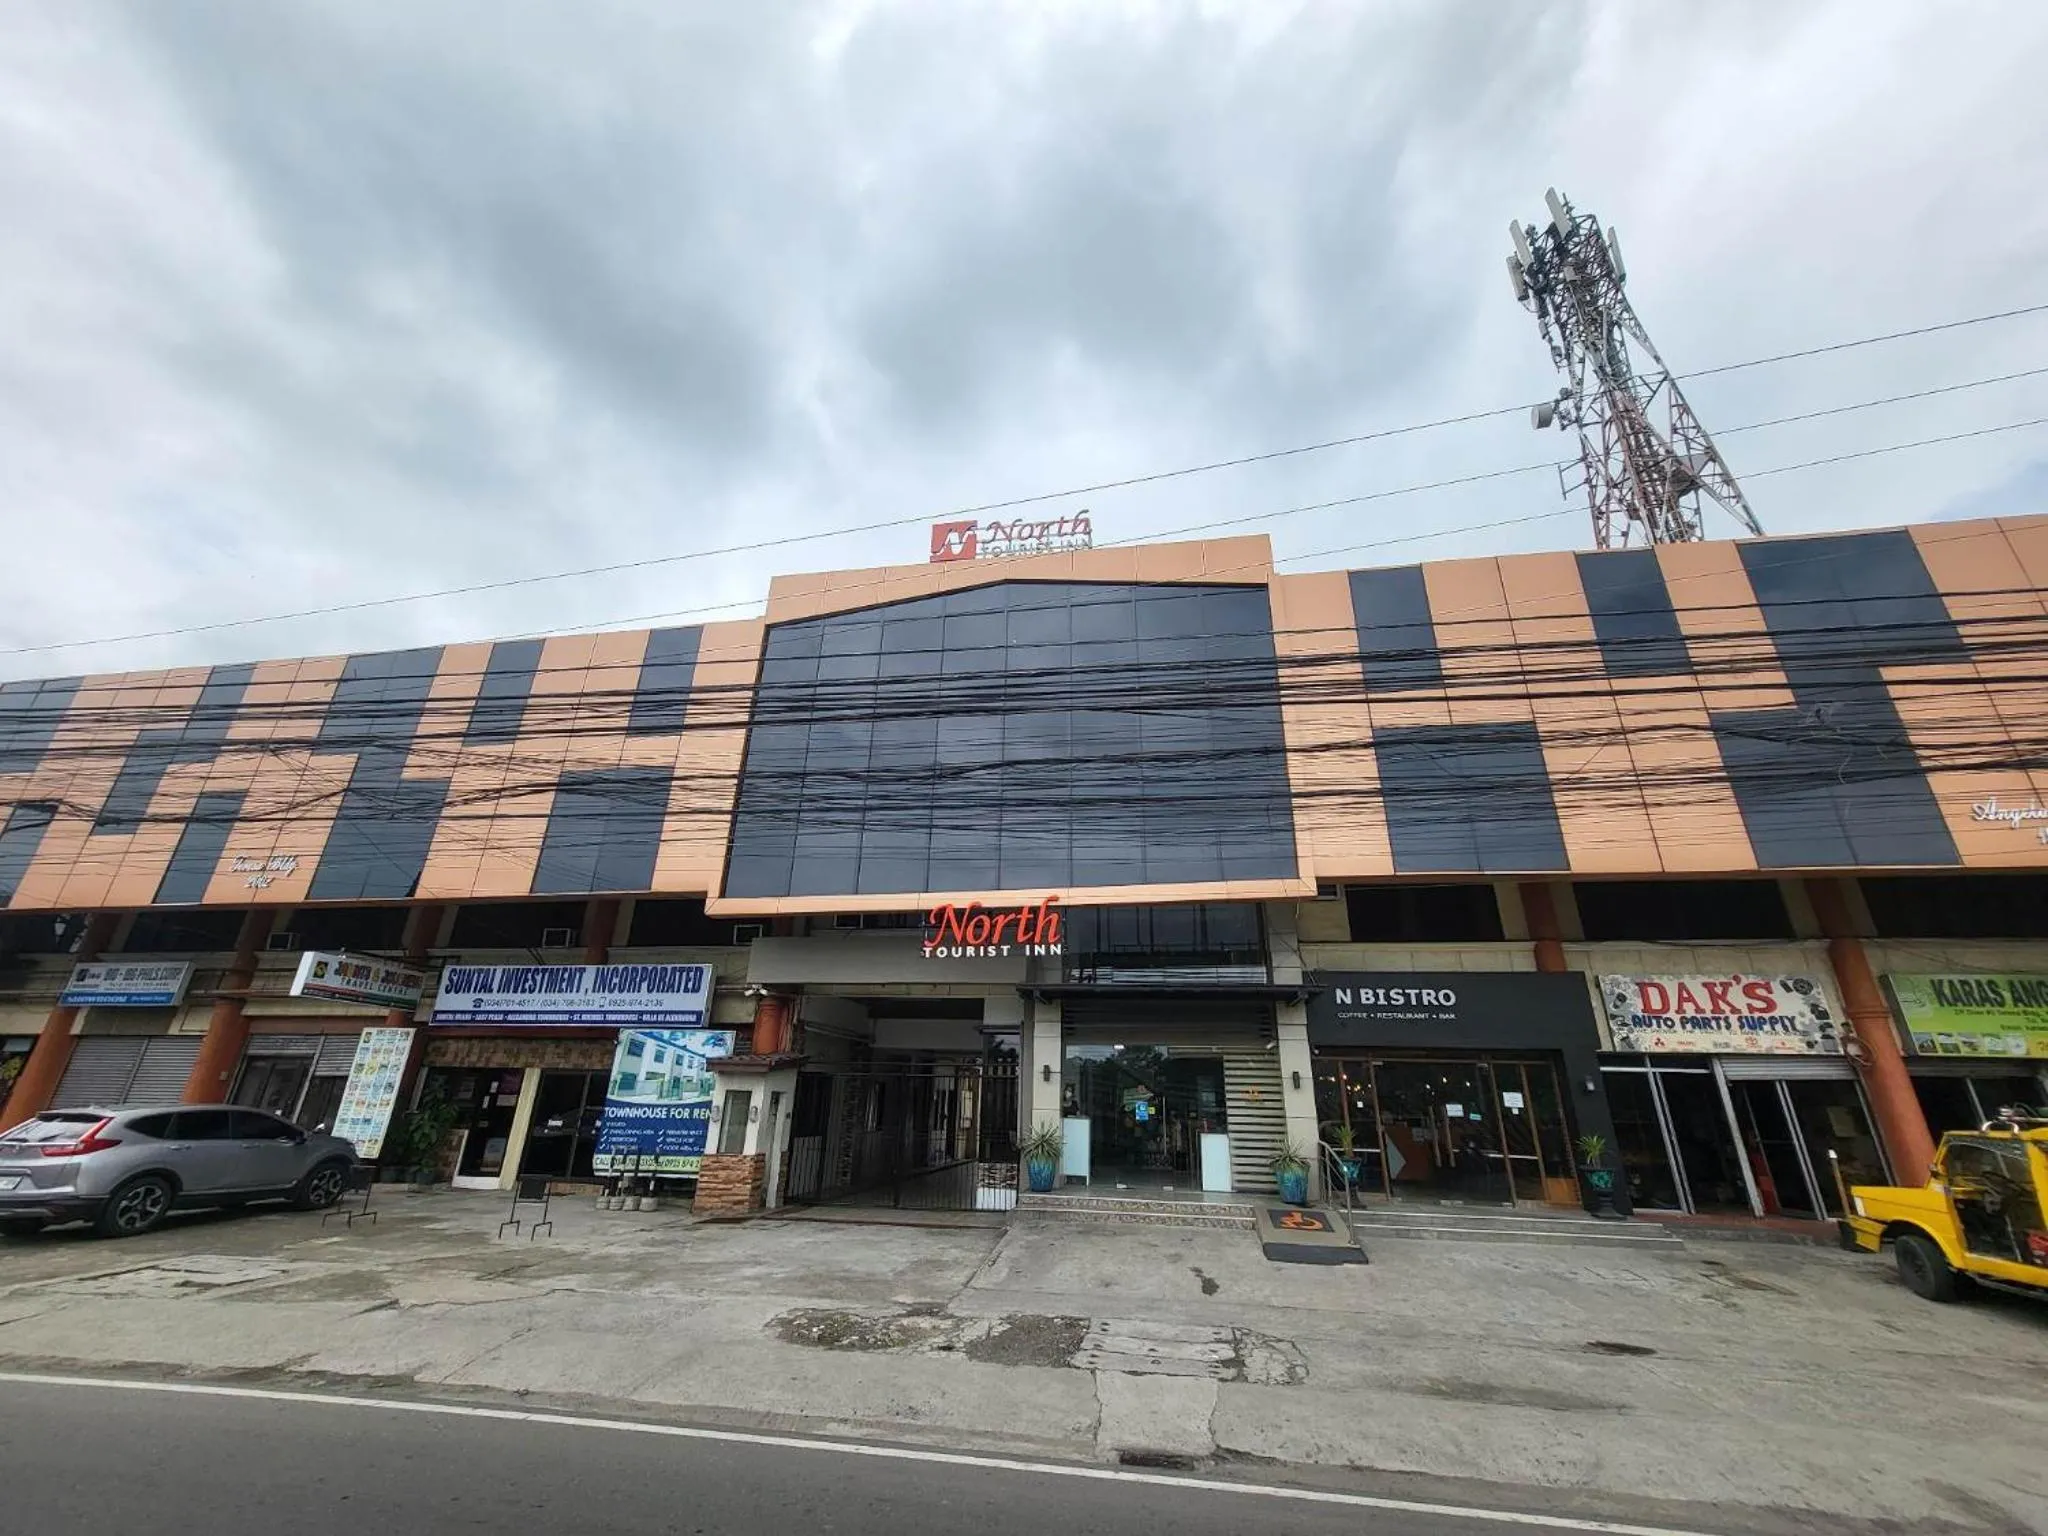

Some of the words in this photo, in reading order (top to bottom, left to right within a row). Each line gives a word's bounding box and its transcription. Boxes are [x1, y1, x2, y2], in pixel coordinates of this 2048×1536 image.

[976, 509, 1092, 543] North
[924, 895, 1060, 947] North
[922, 944, 1011, 958] TOURIST
[1024, 943, 1062, 956] INN
[340, 977, 374, 991] TRAVEL
[445, 967, 497, 994] SUNTAL
[592, 966, 704, 994] INCORPORATED
[1335, 988, 1352, 1004] N
[1359, 988, 1456, 1006] BISTRO
[1636, 974, 1777, 1015] DAK'S
[1930, 978, 2006, 1007] KARAS
[1631, 1015, 1675, 1029] AUTO
[1680, 1015, 1731, 1031] PARTS
[1738, 1016, 1801, 1033] SUPPLY
[604, 1106, 667, 1118] TOWNHOUSE
[669, 1107, 690, 1119] FOR
